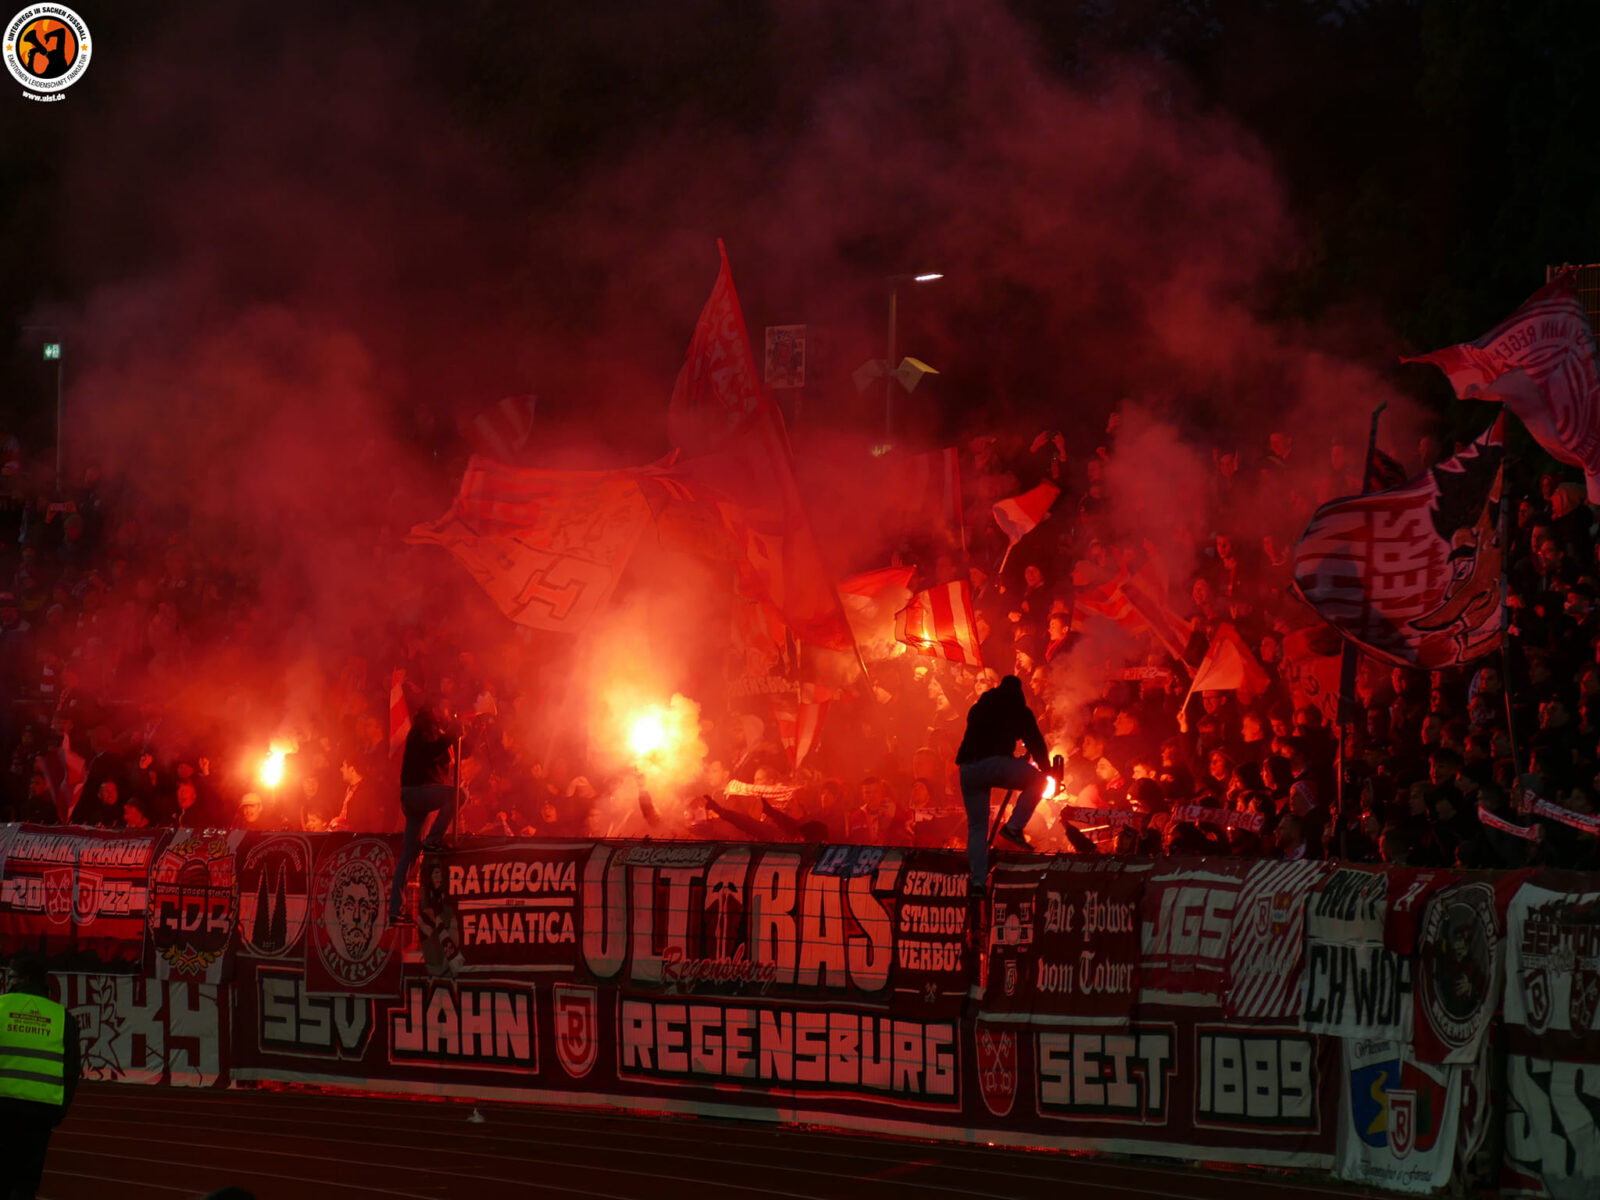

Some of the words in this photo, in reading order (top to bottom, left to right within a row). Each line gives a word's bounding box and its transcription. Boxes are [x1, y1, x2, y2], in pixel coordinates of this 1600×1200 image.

[11, 877, 43, 910] 20
[102, 881, 132, 914] 22
[449, 861, 576, 895] RATISBONA
[462, 912, 575, 946] FANATICA
[582, 843, 906, 992] ULTRAS
[901, 904, 966, 934] STADION
[1042, 892, 1074, 934] Die
[1083, 889, 1134, 942] Power
[1141, 887, 1239, 959] JGS
[660, 946, 778, 996] Regensburg
[1037, 958, 1073, 994] vom
[1079, 951, 1134, 995] Tower
[7, 1023, 51, 1037] SECURITY
[261, 977, 366, 1048] SSV
[395, 986, 531, 1061] JAHN
[622, 1000, 954, 1096] REGENSBURG
[1039, 1031, 1170, 1110] SEIT
[1199, 1034, 1312, 1118] 1889
